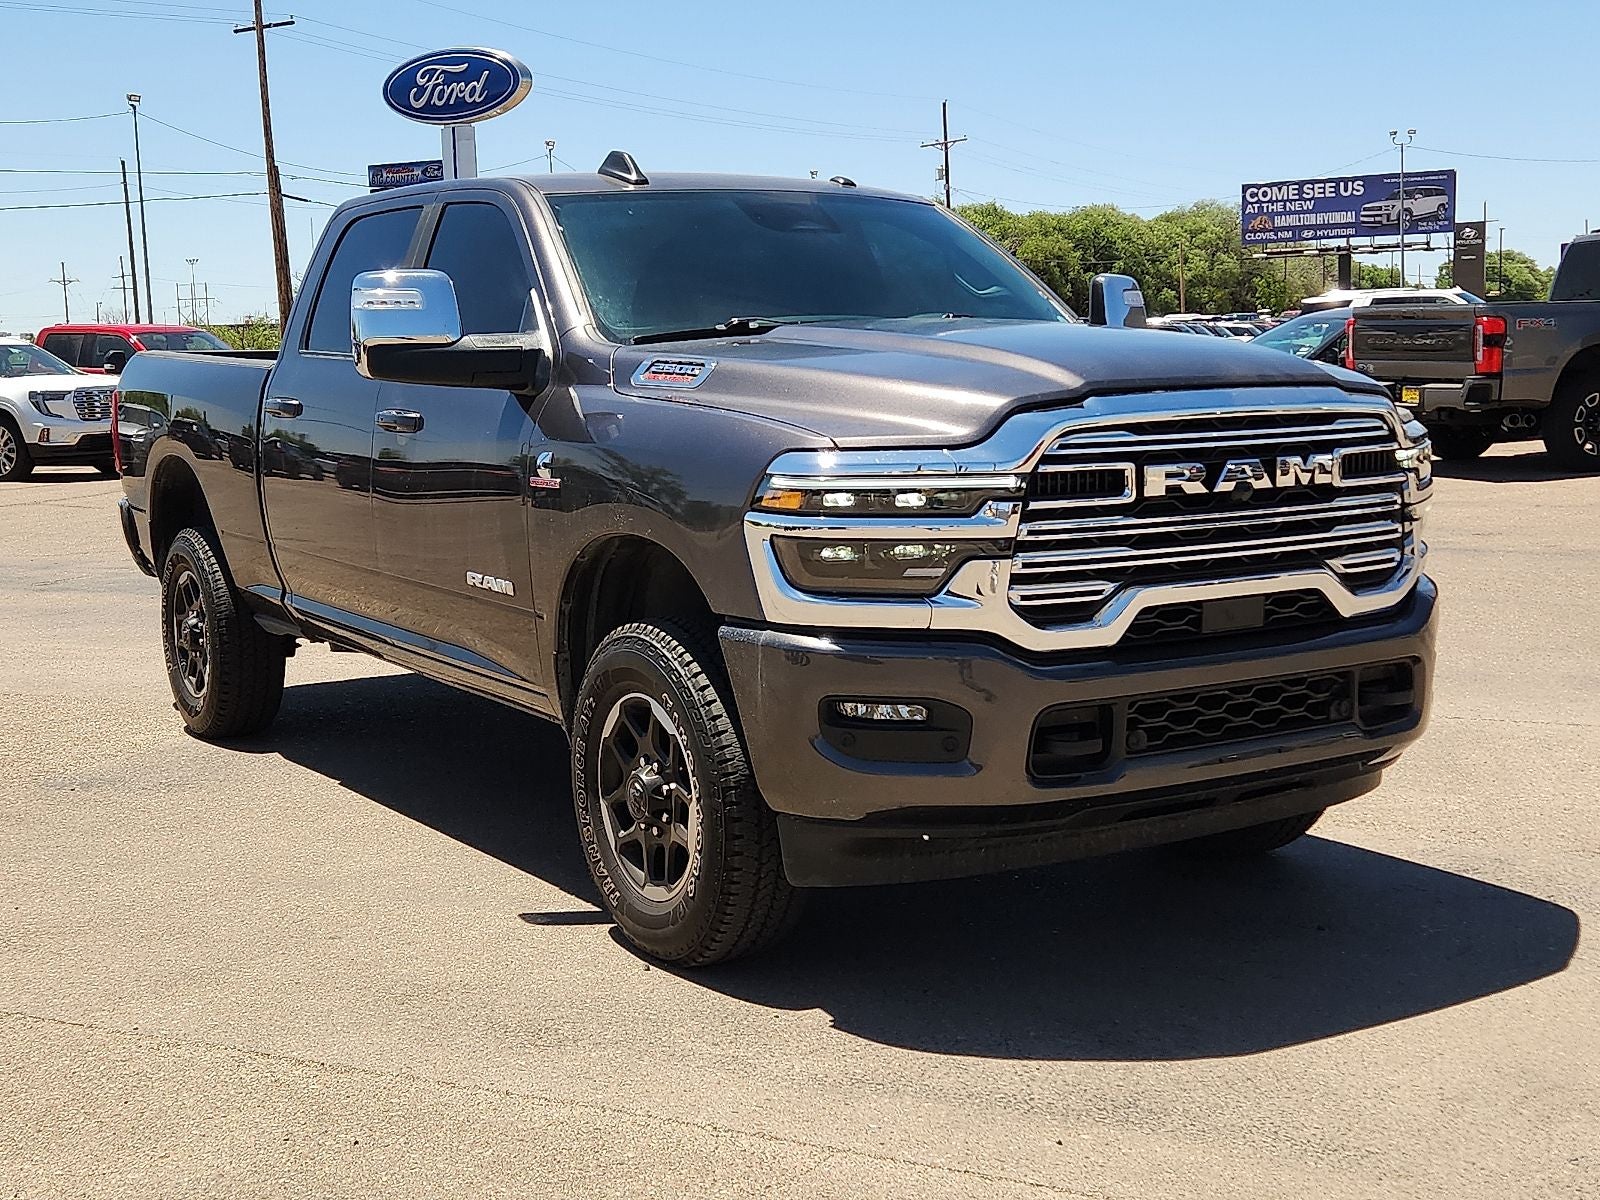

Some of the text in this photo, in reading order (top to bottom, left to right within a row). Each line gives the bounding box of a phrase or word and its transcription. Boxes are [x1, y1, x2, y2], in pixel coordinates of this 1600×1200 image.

[409, 62, 490, 109] Ford
[371, 172, 420, 185] BIG COUNTRY
[426, 165, 443, 177] Ford
[1245, 180, 1365, 203] COME SEE US
[1245, 200, 1315, 214] AT THE NEW
[1245, 227, 1356, 241] CLOVIS, NM HYUNDAI
[1516, 318, 1556, 330] FX4
[1143, 453, 1333, 497] RAM
[466, 571, 515, 597] RAM
[574, 736, 621, 908] TRANSFORCE
